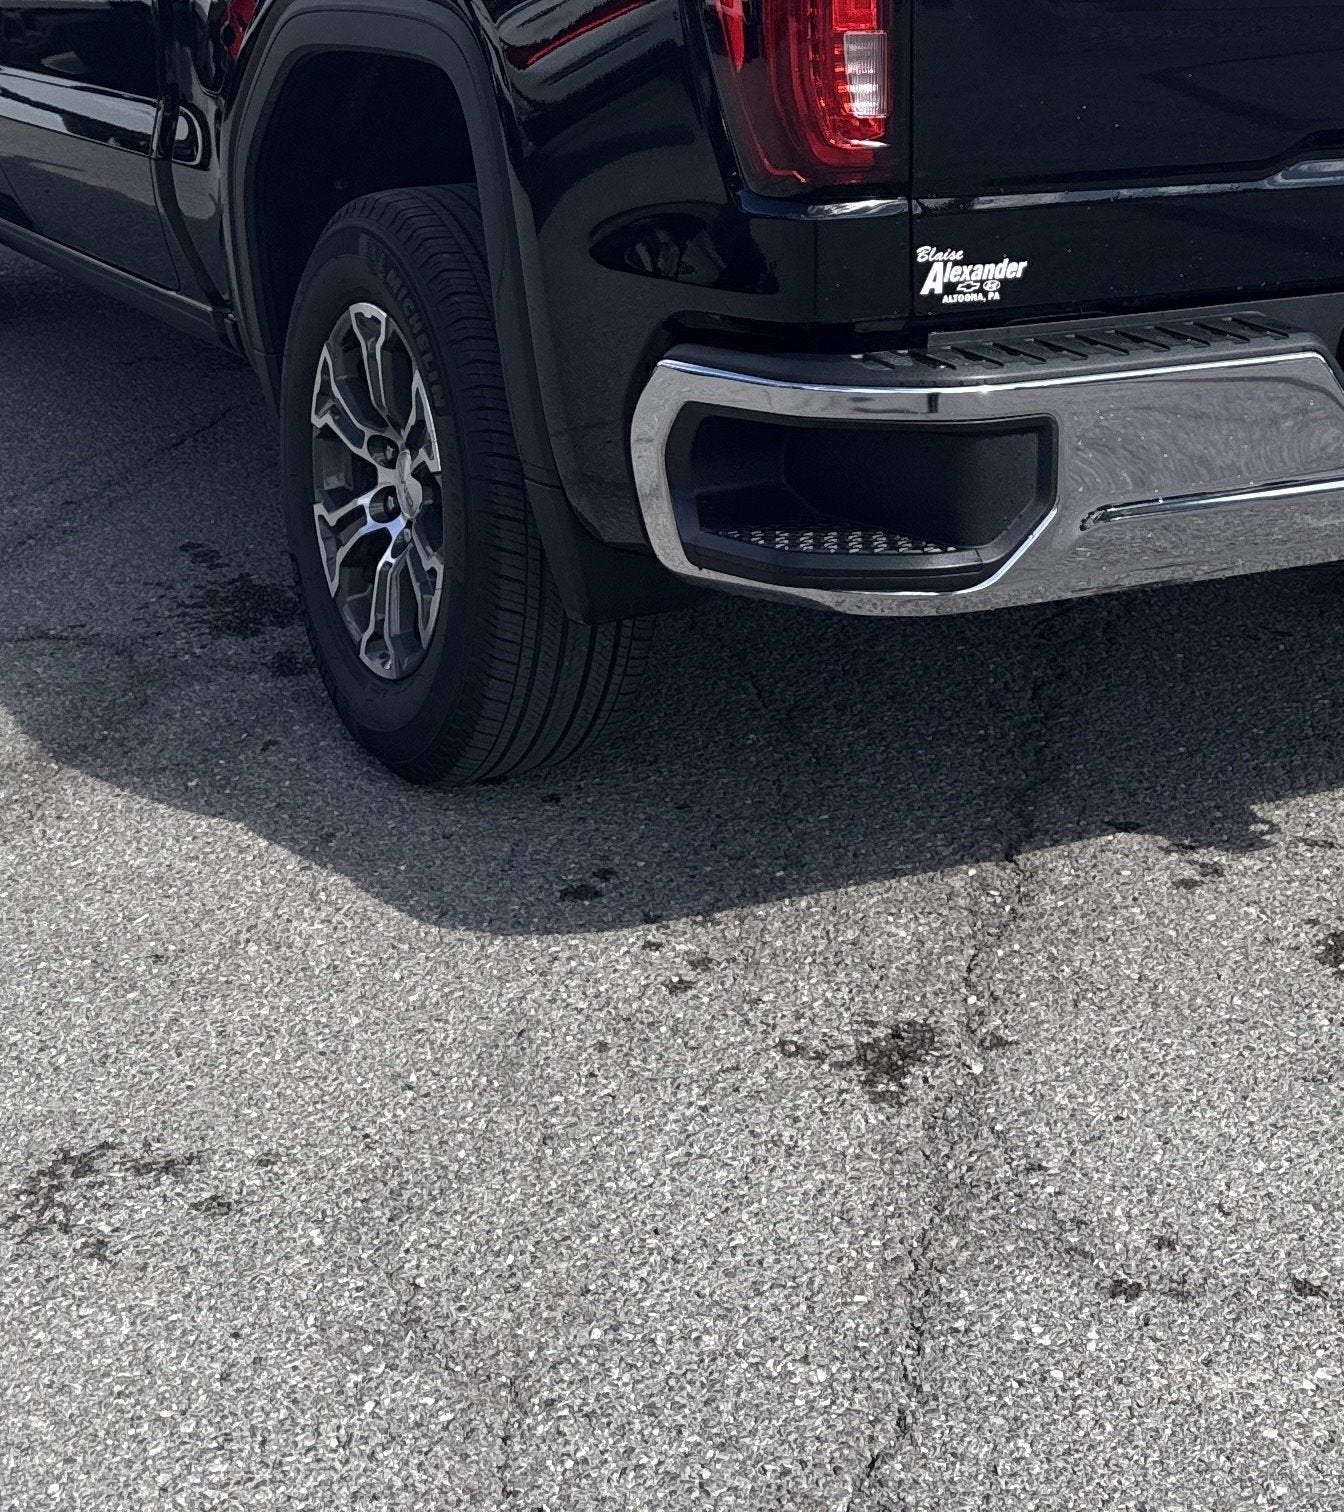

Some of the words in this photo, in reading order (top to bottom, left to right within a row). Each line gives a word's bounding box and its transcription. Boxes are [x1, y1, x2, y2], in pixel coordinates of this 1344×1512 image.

[916, 245, 964, 263] Blaise
[919, 258, 1028, 295] Alexander
[942, 292, 986, 304] ALTOONA,
[988, 291, 1001, 301] PA
